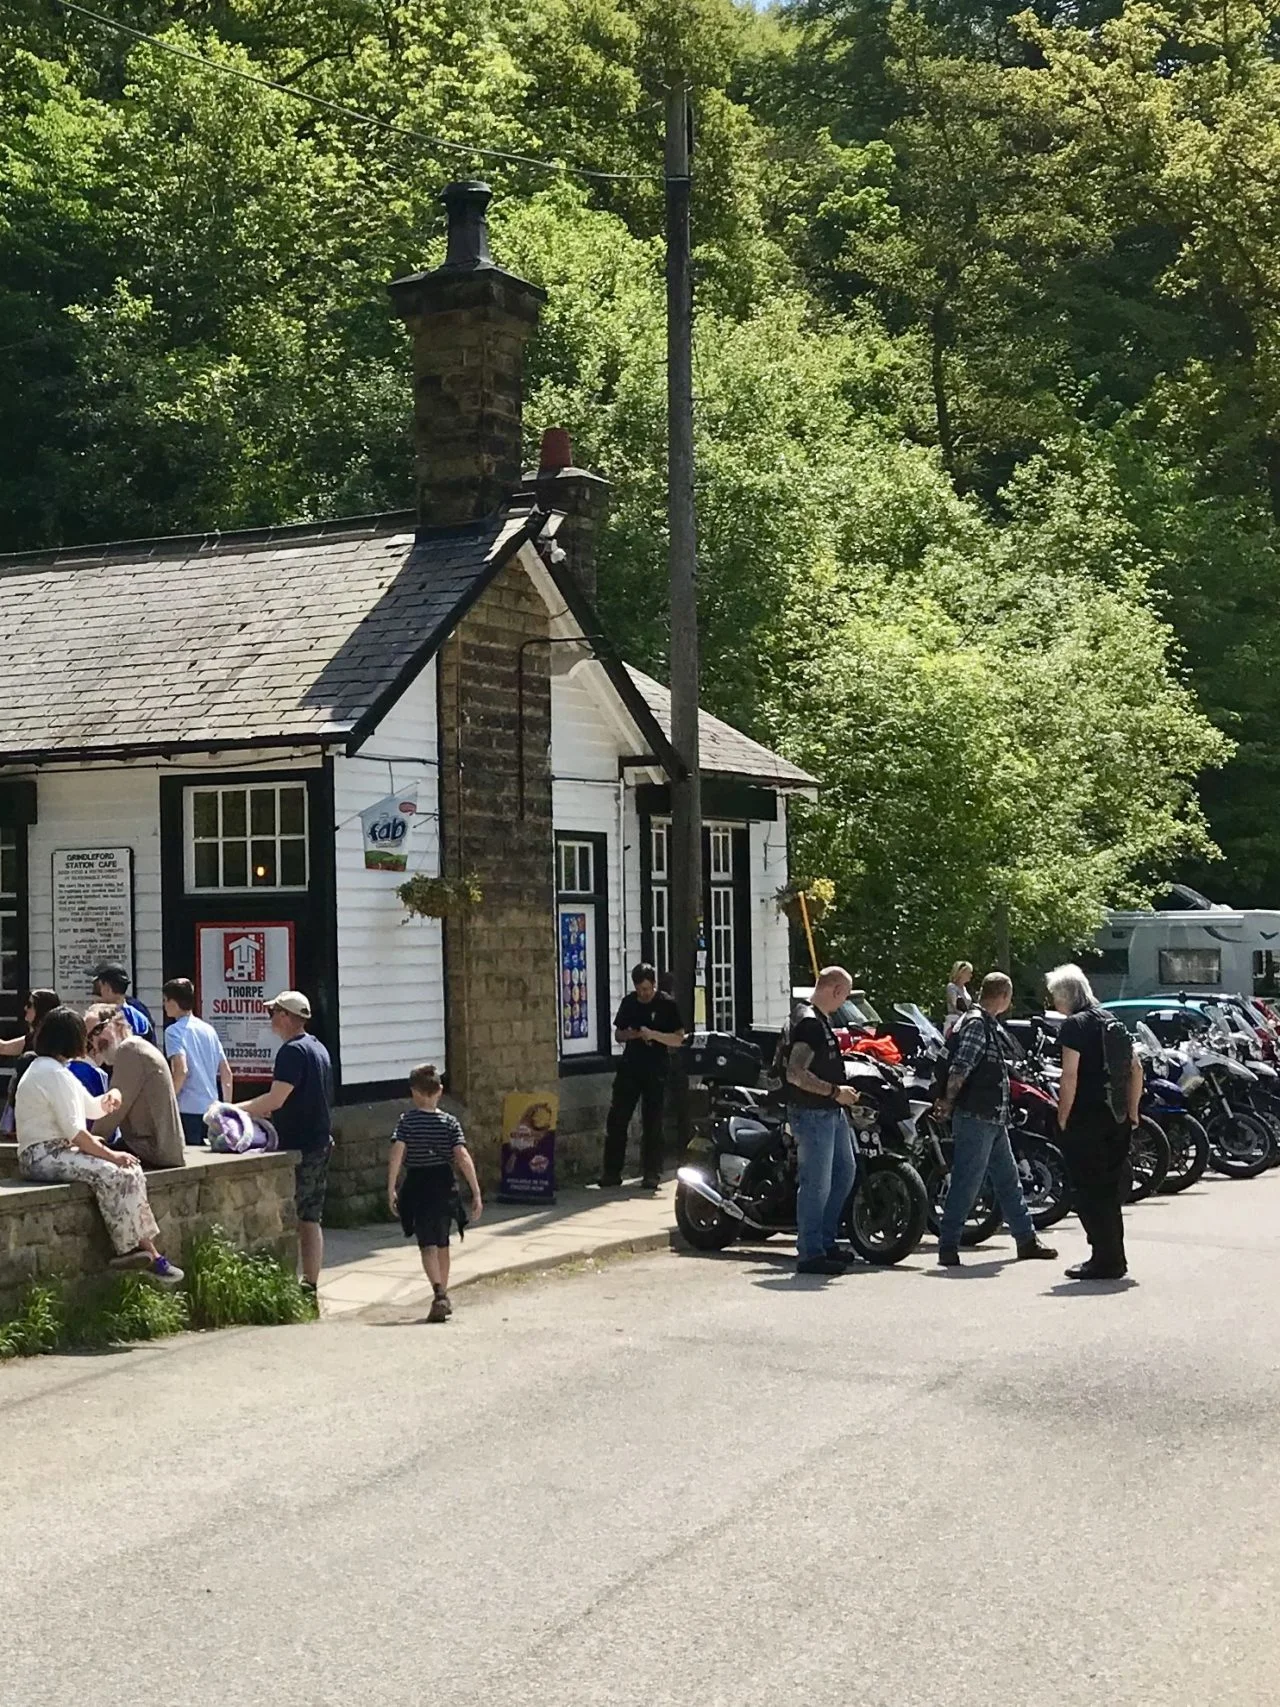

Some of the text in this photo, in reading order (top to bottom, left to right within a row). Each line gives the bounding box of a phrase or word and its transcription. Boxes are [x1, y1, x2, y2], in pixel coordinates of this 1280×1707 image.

[368, 818, 406, 841] fab
[66, 853, 115, 861] GRINDLEFORD
[65, 860, 118, 869] STATION CAFE
[227, 986, 264, 998] THORPE
